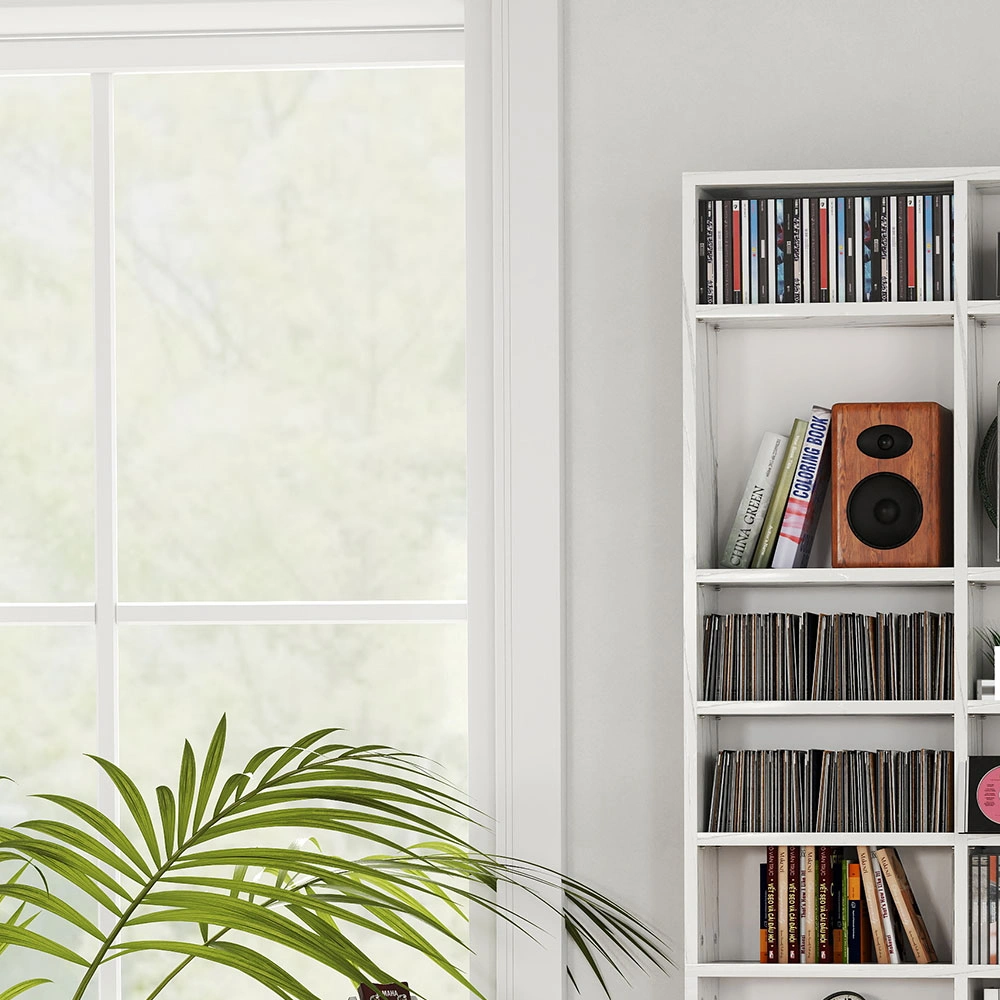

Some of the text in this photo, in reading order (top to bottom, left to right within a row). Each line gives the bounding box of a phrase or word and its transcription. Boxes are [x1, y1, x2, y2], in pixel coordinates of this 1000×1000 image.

[793, 415, 829, 500] COLORING BOOK
[730, 485, 765, 567] CHINA GREEN
